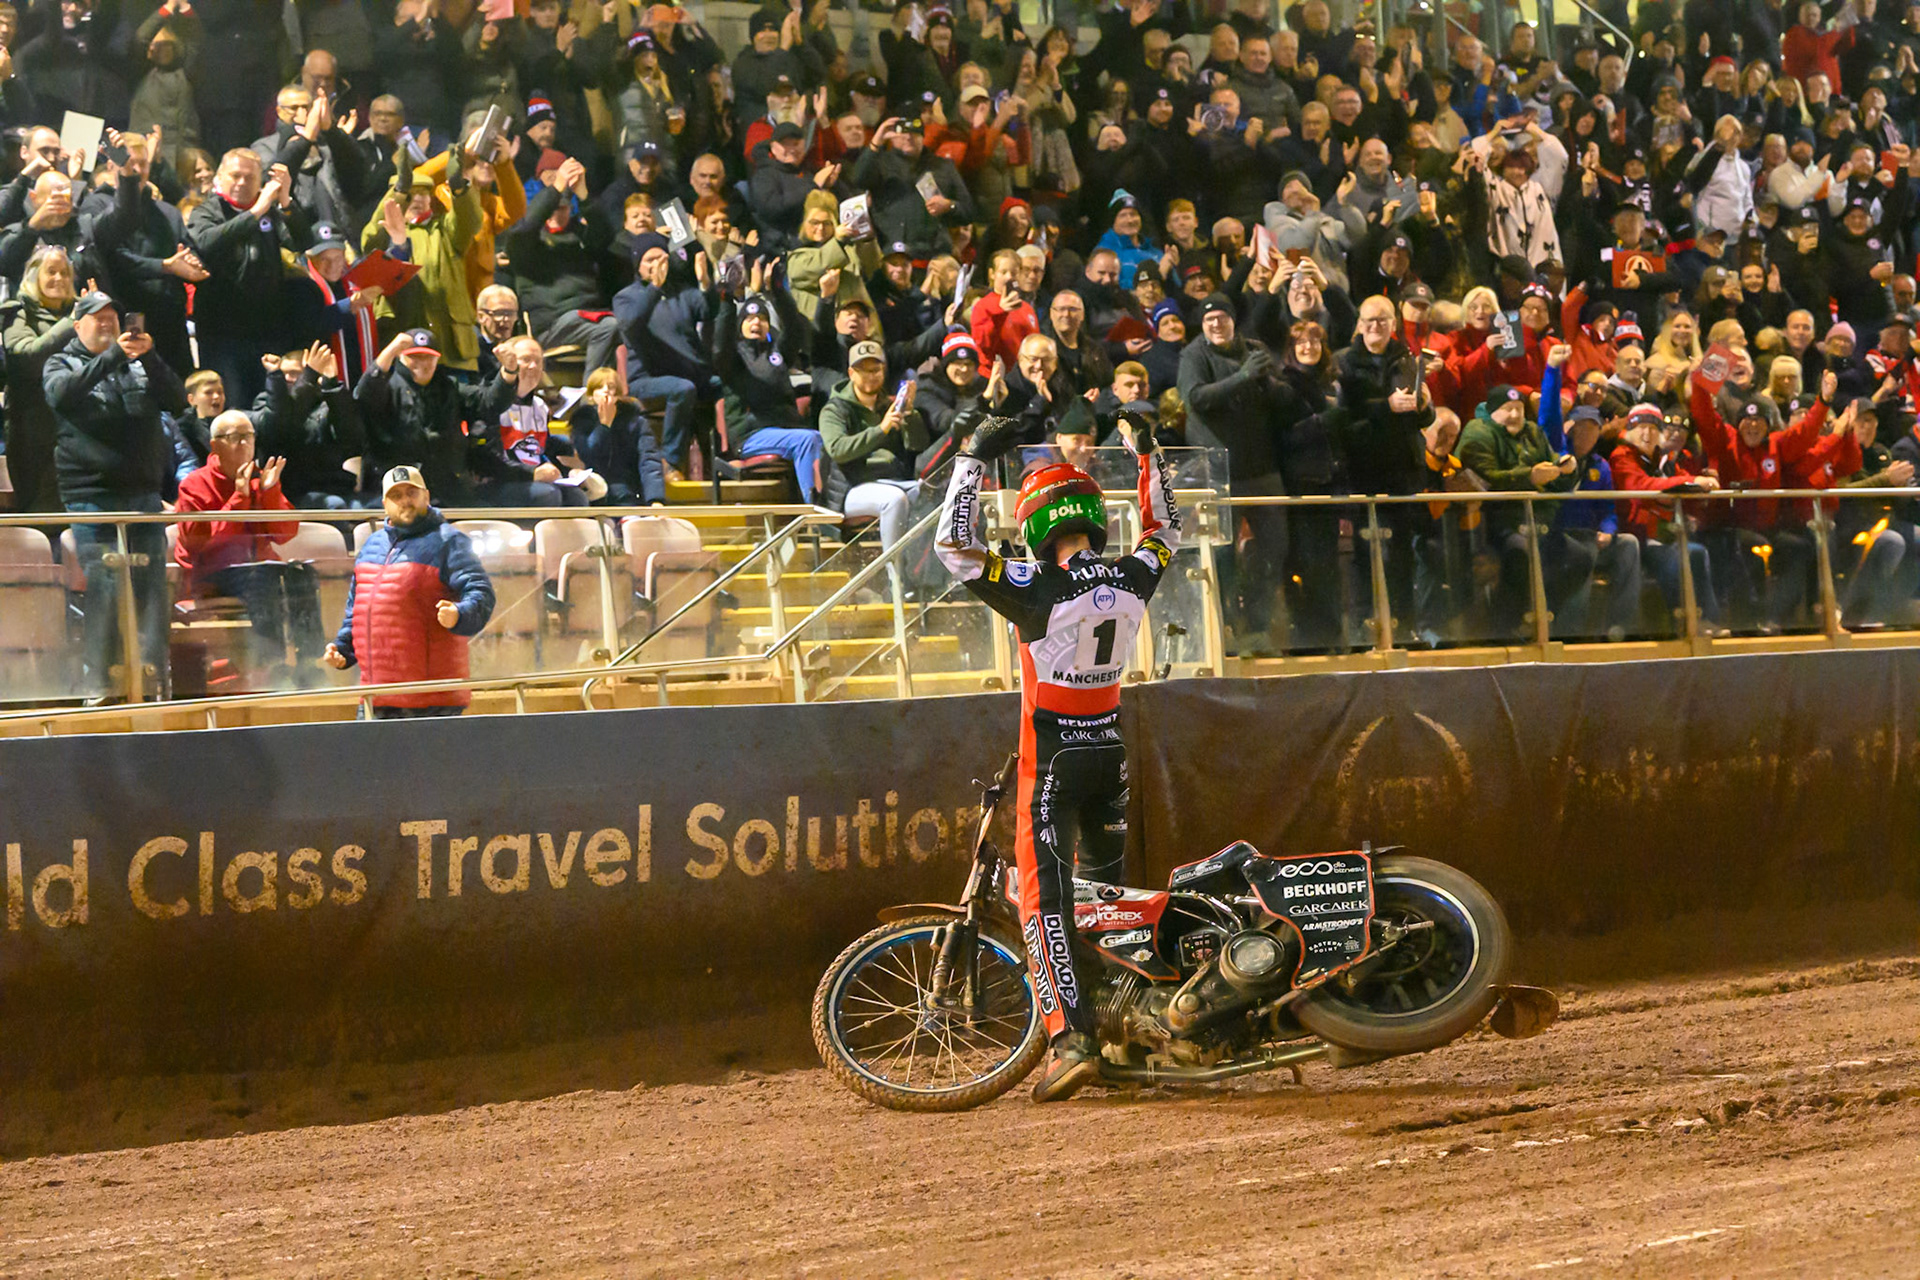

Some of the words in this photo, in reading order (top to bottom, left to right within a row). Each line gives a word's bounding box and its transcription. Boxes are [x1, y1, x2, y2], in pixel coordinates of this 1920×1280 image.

[1048, 503, 1084, 522] BOLL
[1096, 594, 1114, 603] ATPI
[1092, 618, 1117, 666] 1
[1052, 666, 1124, 684] MANCHESTE
[127, 831, 368, 920] Class
[399, 803, 653, 900] Travel
[684, 790, 1017, 881] Solution
[1283, 880, 1367, 899] BECKHOFF
[1044, 914, 1079, 1008] daytona
